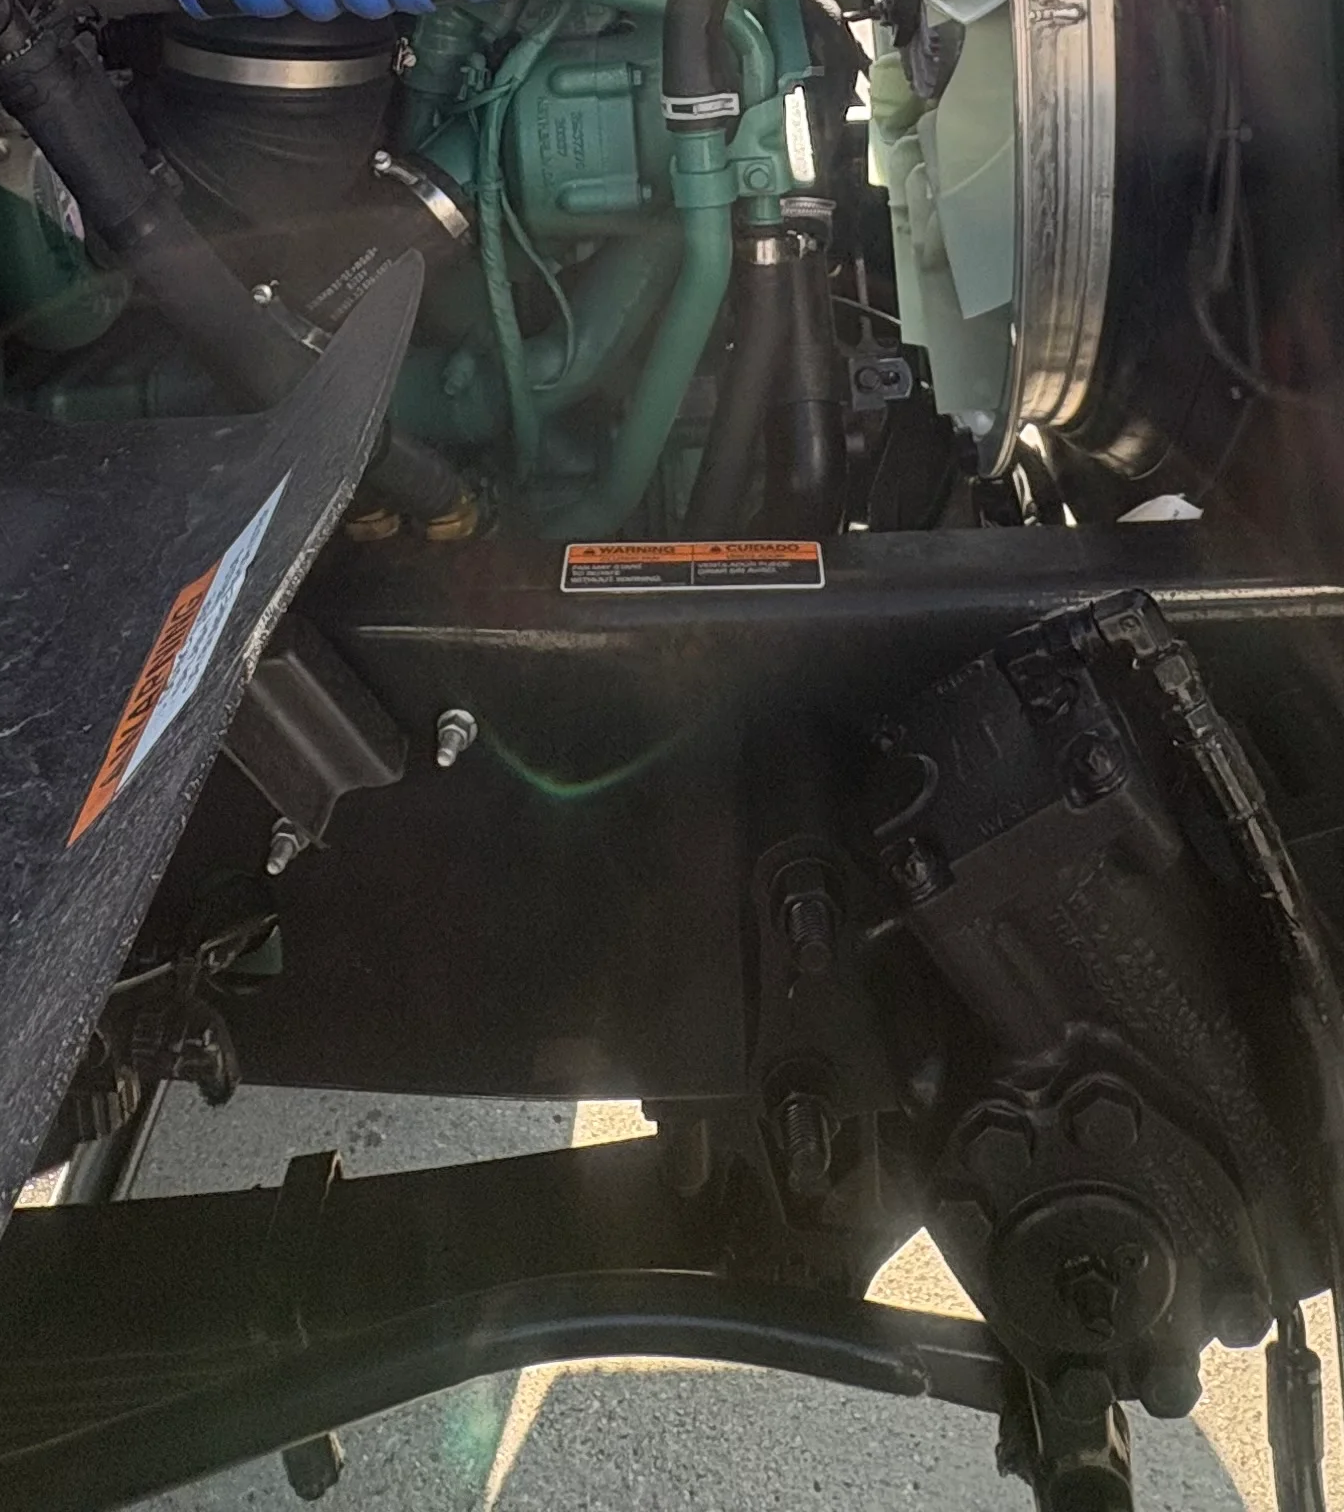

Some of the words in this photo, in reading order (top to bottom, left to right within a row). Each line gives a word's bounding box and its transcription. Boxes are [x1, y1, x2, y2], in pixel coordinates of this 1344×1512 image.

[599, 545, 675, 554] WARNING
[725, 544, 800, 553] CUIDADO
[108, 591, 205, 769] WARNING
